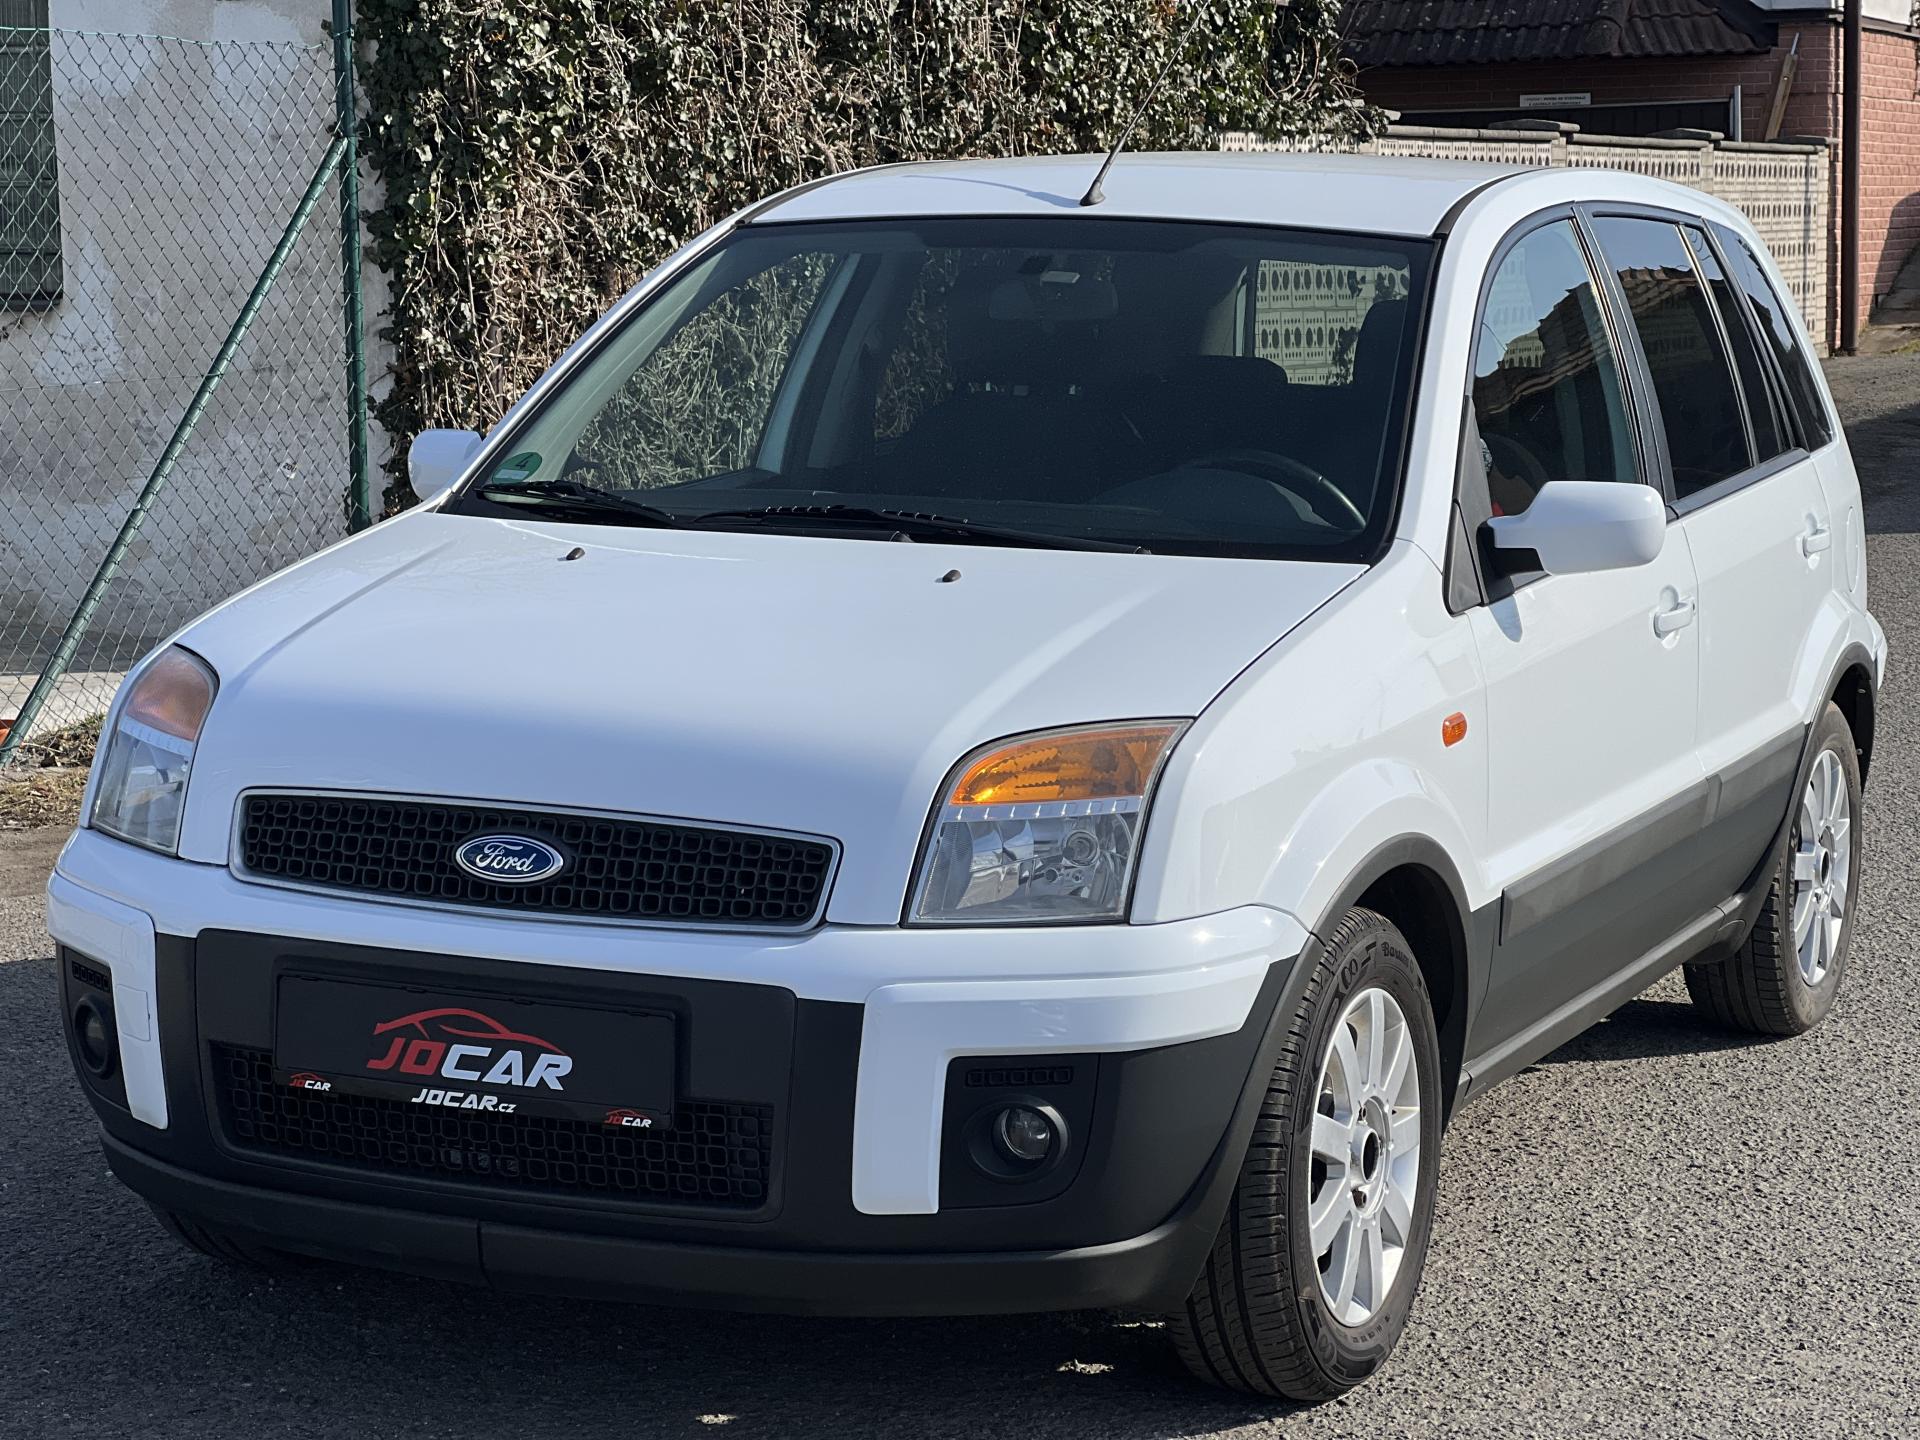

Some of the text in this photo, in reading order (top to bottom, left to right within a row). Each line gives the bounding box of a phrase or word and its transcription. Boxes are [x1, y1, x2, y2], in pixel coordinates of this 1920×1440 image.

[515, 453, 534, 470] 4
[475, 842, 537, 872] Ford
[366, 1037, 573, 1091] JOCAR
[288, 1077, 331, 1093] JOCAR
[603, 1112, 653, 1129] JOCAR
